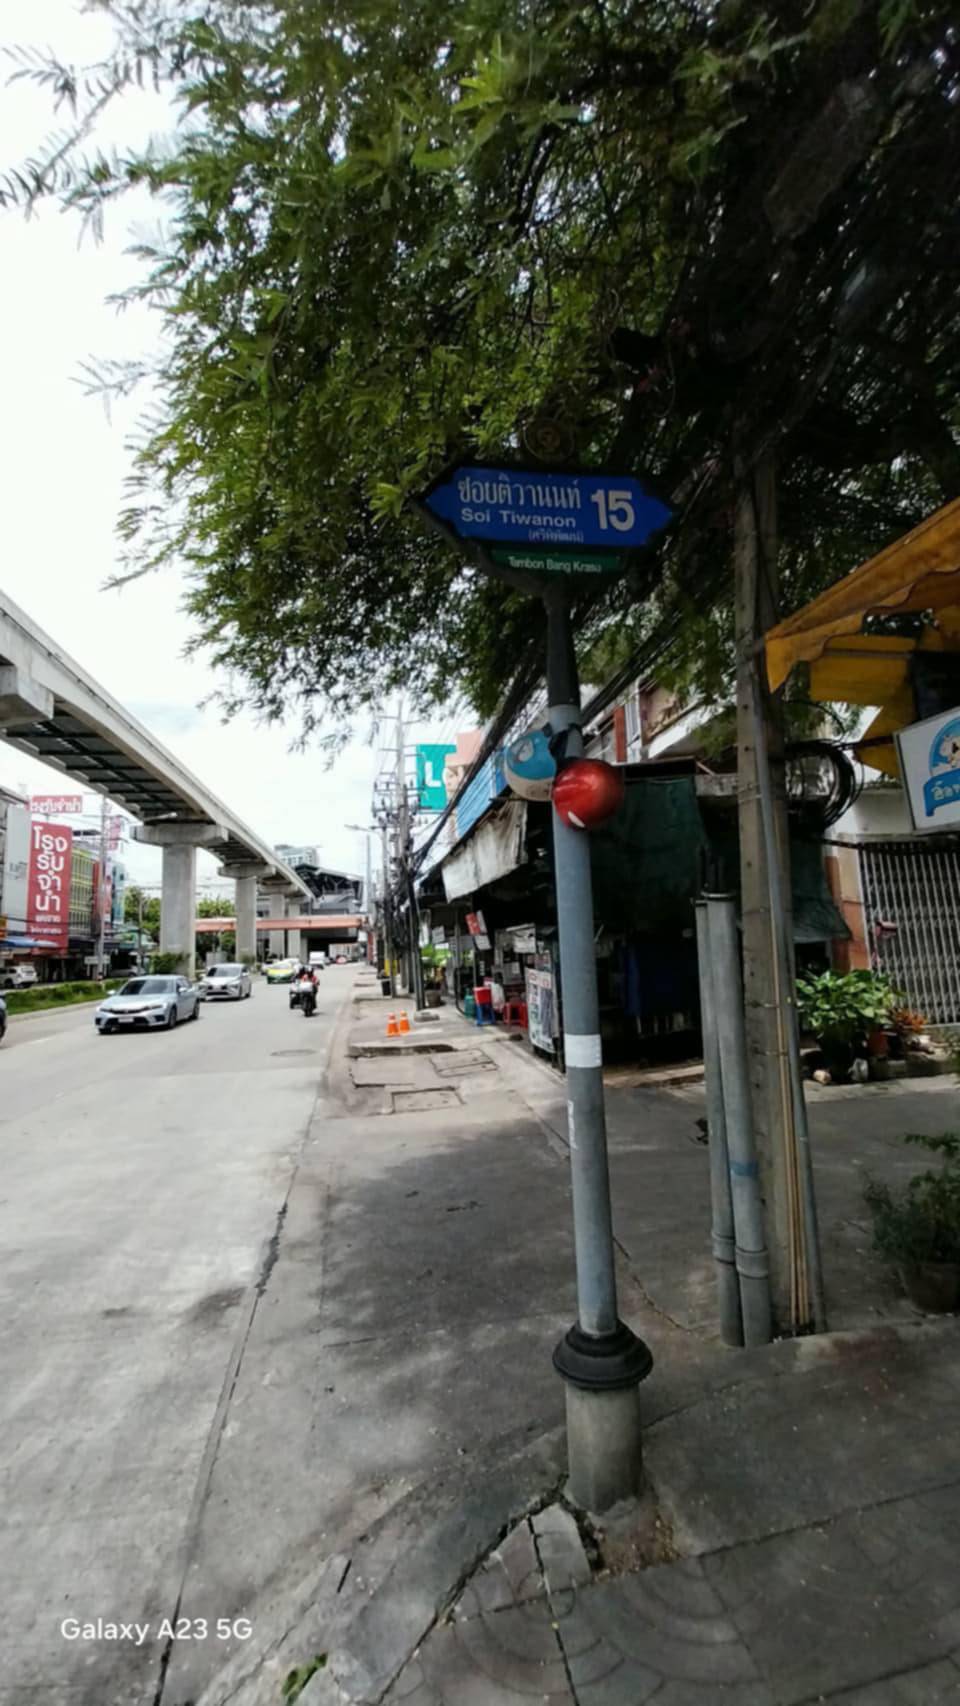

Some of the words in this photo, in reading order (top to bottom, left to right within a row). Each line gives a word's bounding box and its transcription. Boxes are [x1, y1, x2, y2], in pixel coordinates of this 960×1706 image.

[461, 508, 490, 523] Soi
[499, 510, 576, 528] Tiwanon
[591, 489, 636, 532] 15
[508, 555, 544, 569] Tambon
[546, 558, 572, 574] Bang
[33, 826, 68, 853] โรง
[37, 850, 64, 872] รับ
[38, 870, 61, 891] จำ
[35, 890, 61, 912] นำ
